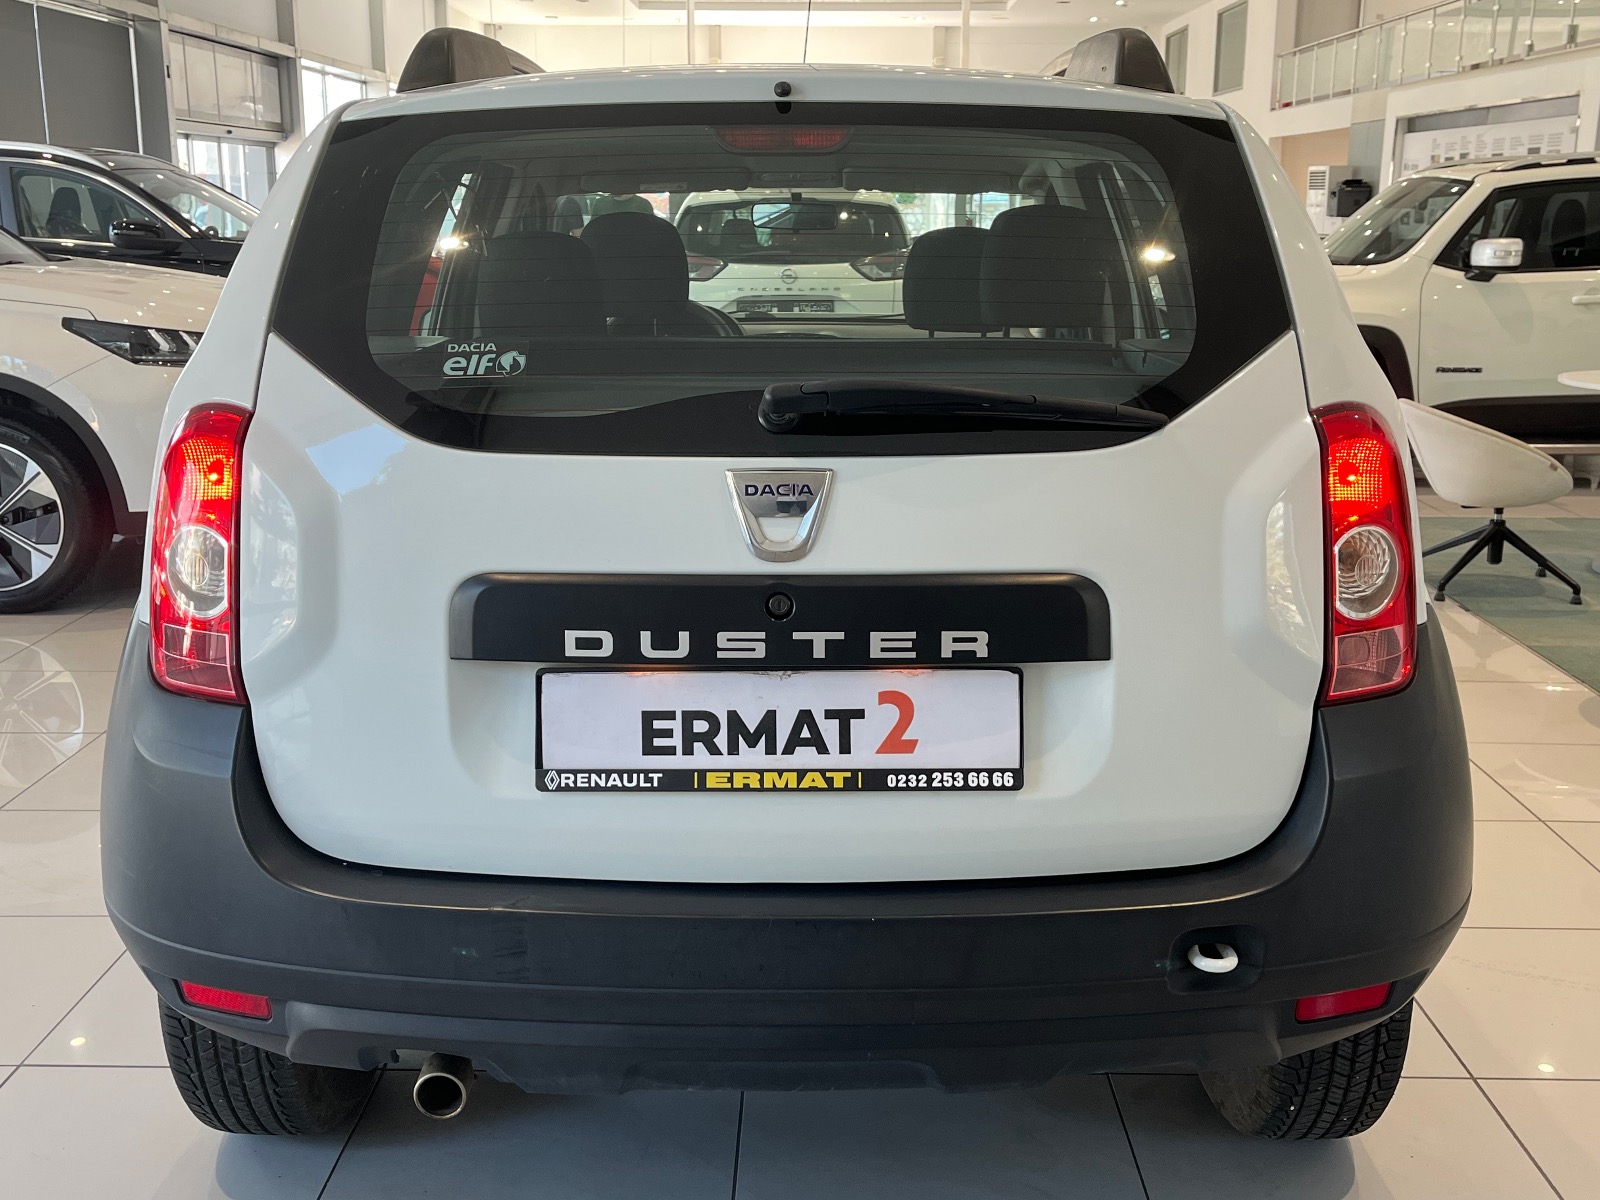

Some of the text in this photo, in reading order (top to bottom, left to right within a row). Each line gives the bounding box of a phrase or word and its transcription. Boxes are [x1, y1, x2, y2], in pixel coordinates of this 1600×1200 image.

[447, 343, 497, 353] DACIA
[442, 353, 497, 376] elf
[744, 484, 814, 497] DACIA
[564, 629, 990, 659] DUSTER
[641, 690, 920, 756] ERMAT 2
[560, 773, 663, 788] RENAULT
[705, 771, 852, 789] ERMAT
[887, 774, 928, 788] 0232
[931, 772, 965, 788] 253
